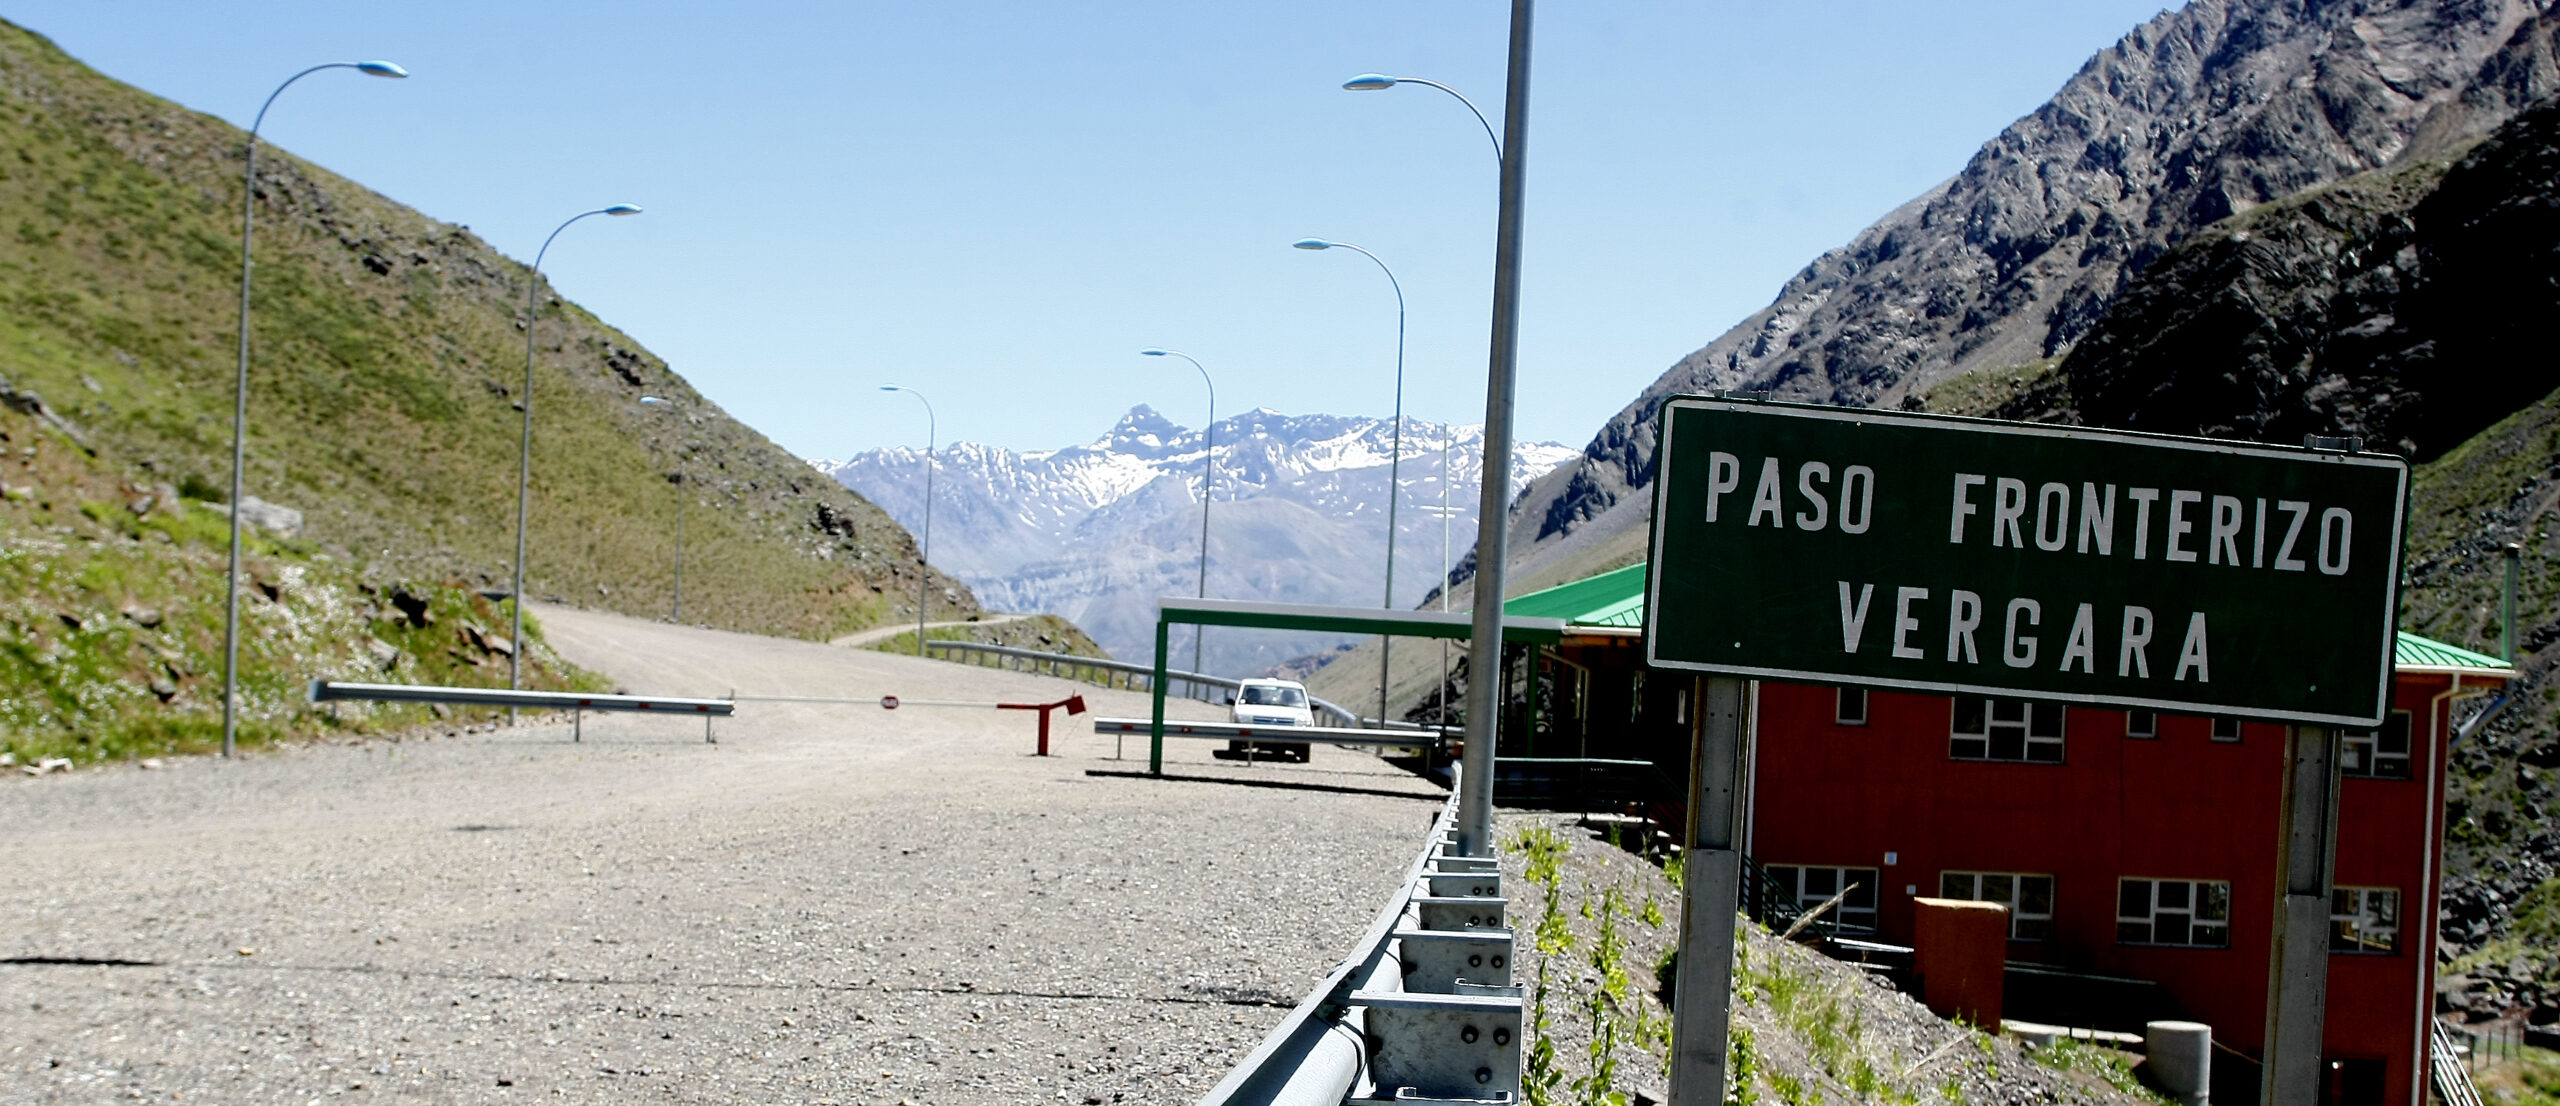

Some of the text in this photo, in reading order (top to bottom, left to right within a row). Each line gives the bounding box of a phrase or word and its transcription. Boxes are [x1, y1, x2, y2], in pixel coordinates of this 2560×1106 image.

[1705, 451, 2353, 576] PASO FRONTERIZO
[1838, 580, 2209, 683] VERGARA
